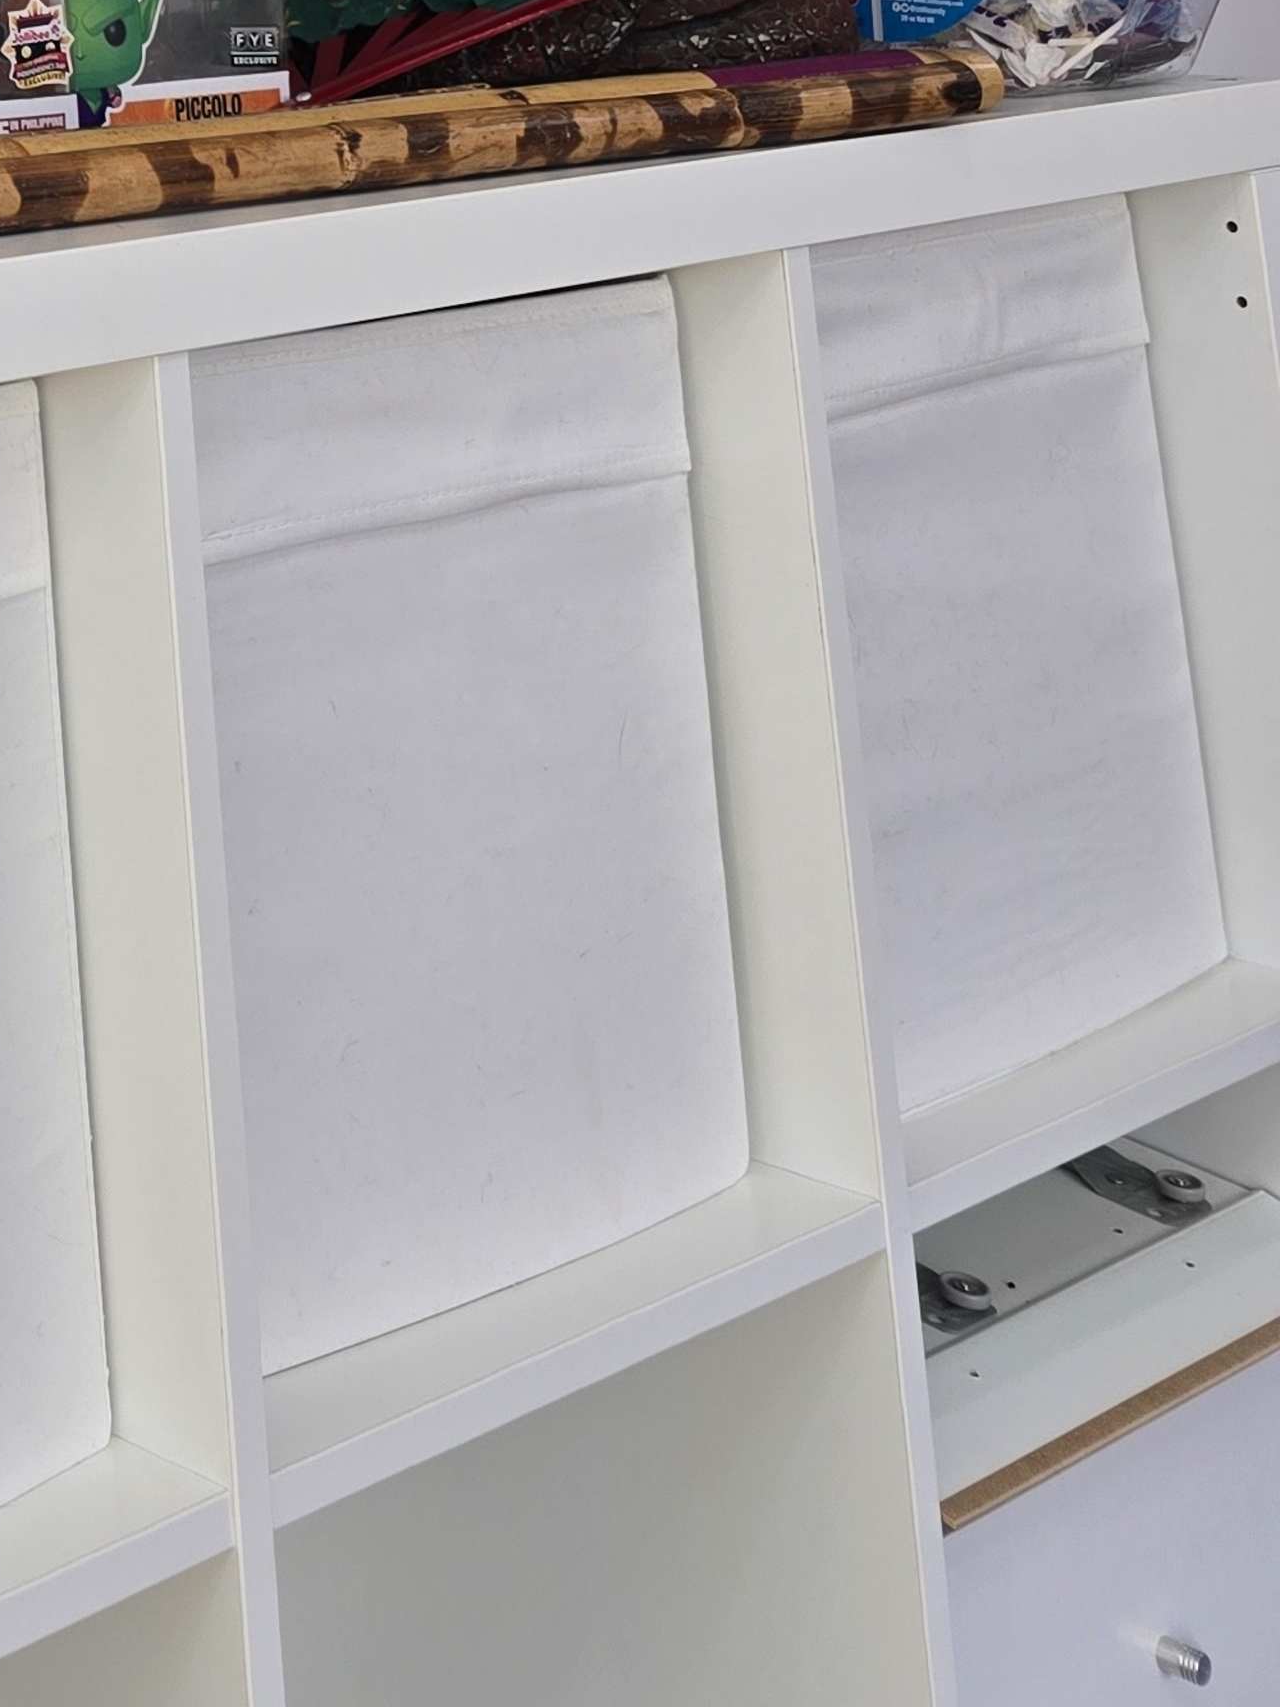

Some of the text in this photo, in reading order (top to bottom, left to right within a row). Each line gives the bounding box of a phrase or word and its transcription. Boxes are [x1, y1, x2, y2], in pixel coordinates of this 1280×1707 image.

[236, 33, 274, 47] FYE
[233, 56, 278, 65] EXCLUSIVE
[175, 93, 242, 122] PICCOLO
